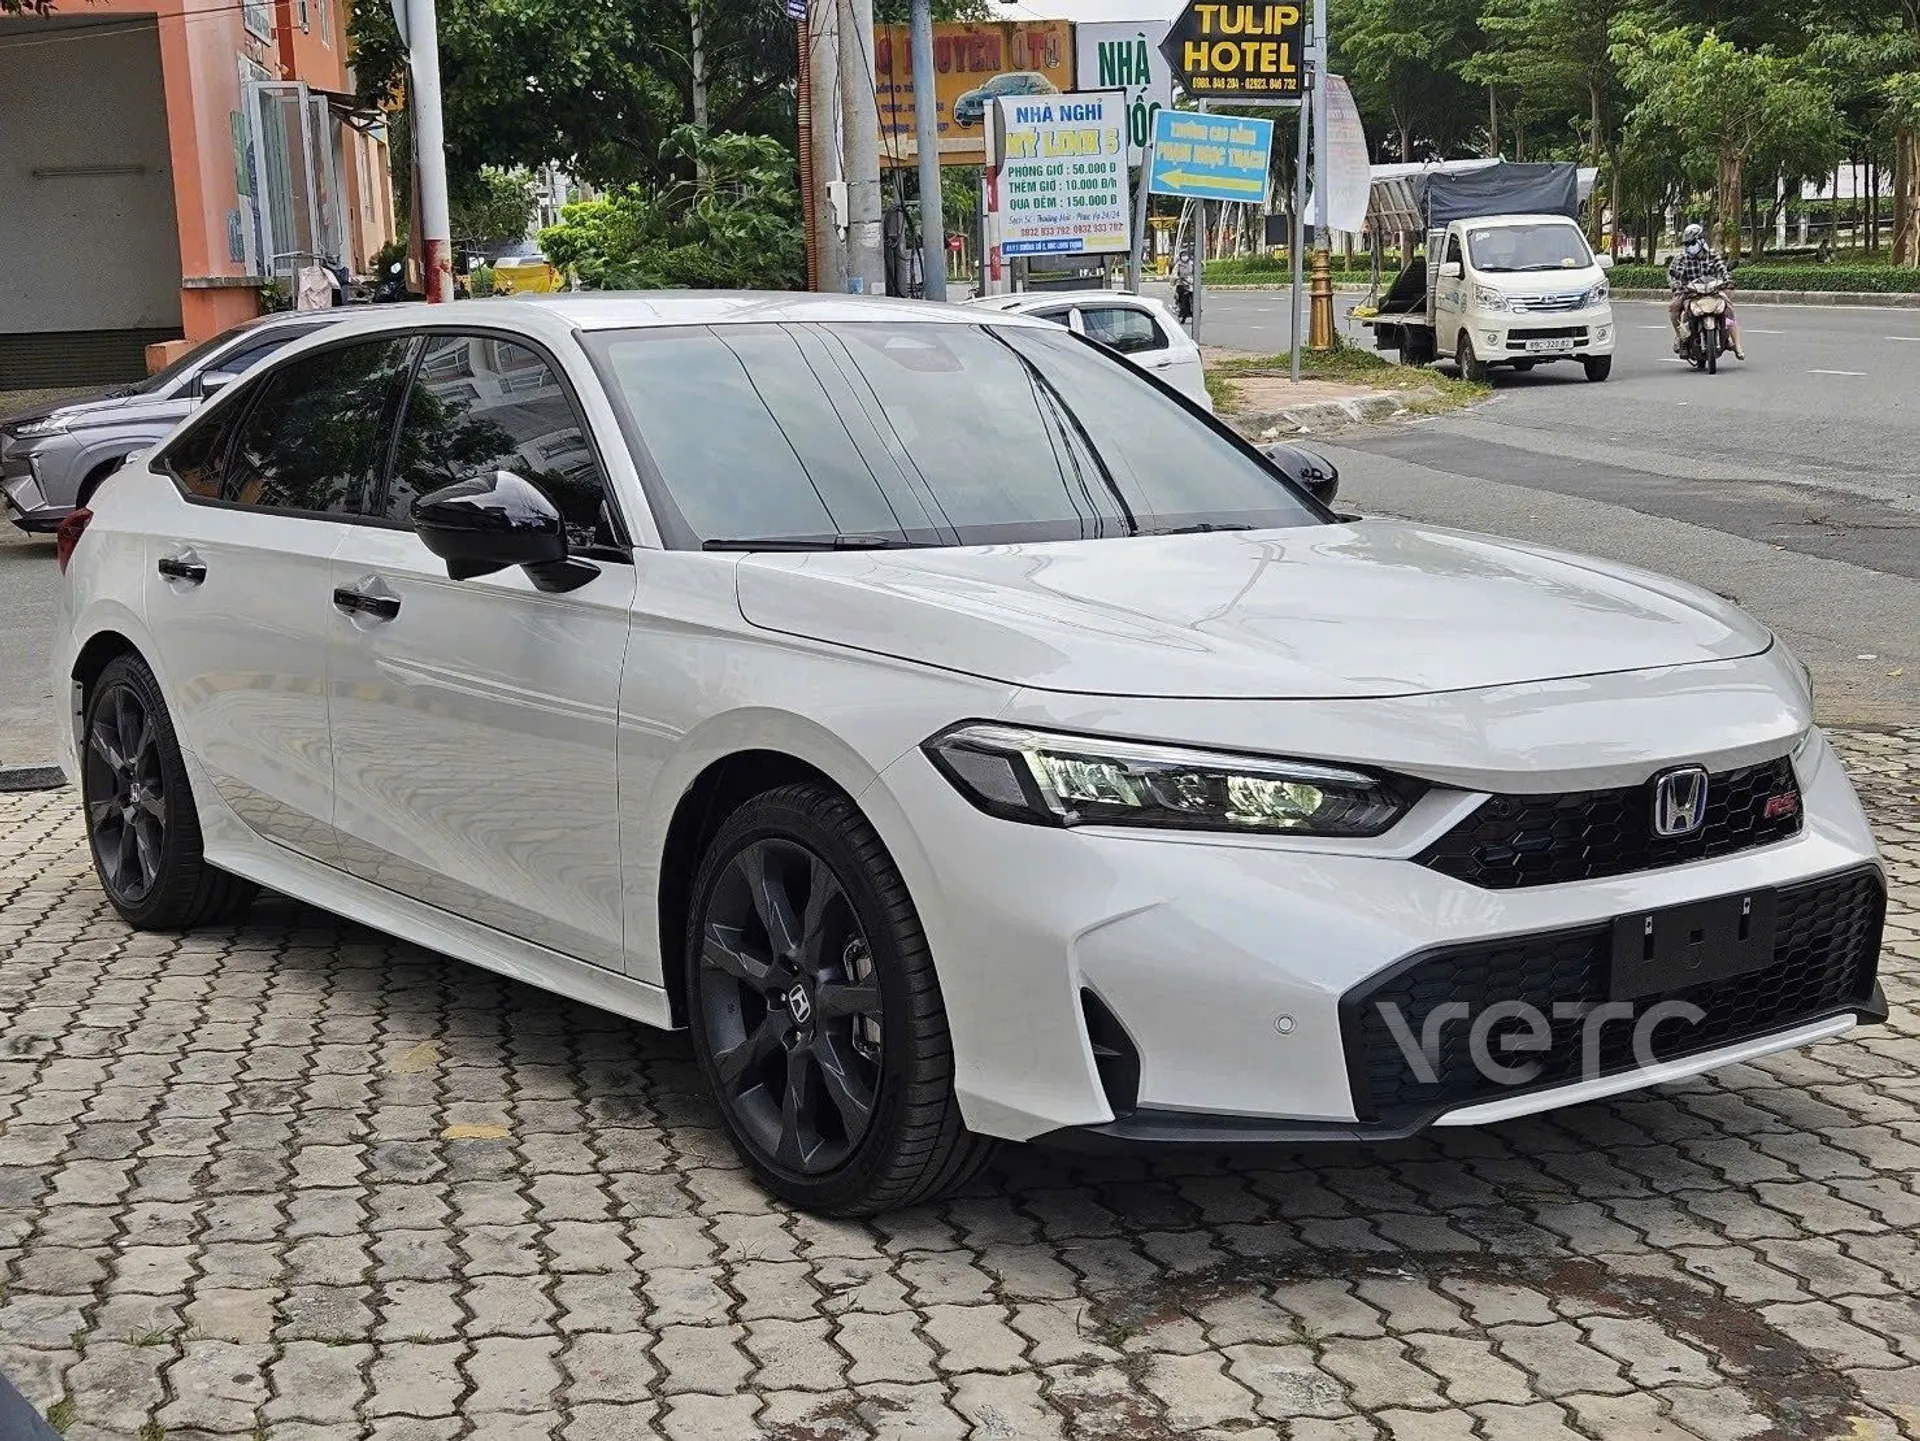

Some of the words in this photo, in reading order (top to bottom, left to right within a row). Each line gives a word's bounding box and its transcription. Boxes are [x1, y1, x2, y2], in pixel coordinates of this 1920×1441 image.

[1194, 5, 1299, 35] TULIP
[1098, 32, 1150, 86] NHÀ
[1184, 41, 1296, 73] HOTEL
[1016, 103, 1054, 123] NHÀ
[1060, 98, 1102, 121] NGHỈ
[1008, 163, 1043, 178] PHÒNG
[1046, 162, 1063, 176] GIỜ
[1072, 163, 1107, 175] 50.000
[1009, 179, 1037, 193] THÊM
[1039, 178, 1056, 192] GIỜ
[1066, 179, 1098, 191] 10.000
[1010, 198, 1030, 211] QUA
[1033, 195, 1057, 209] ĐÊM
[1067, 195, 1107, 207] 150.000
[1763, 790, 1798, 819] RS
